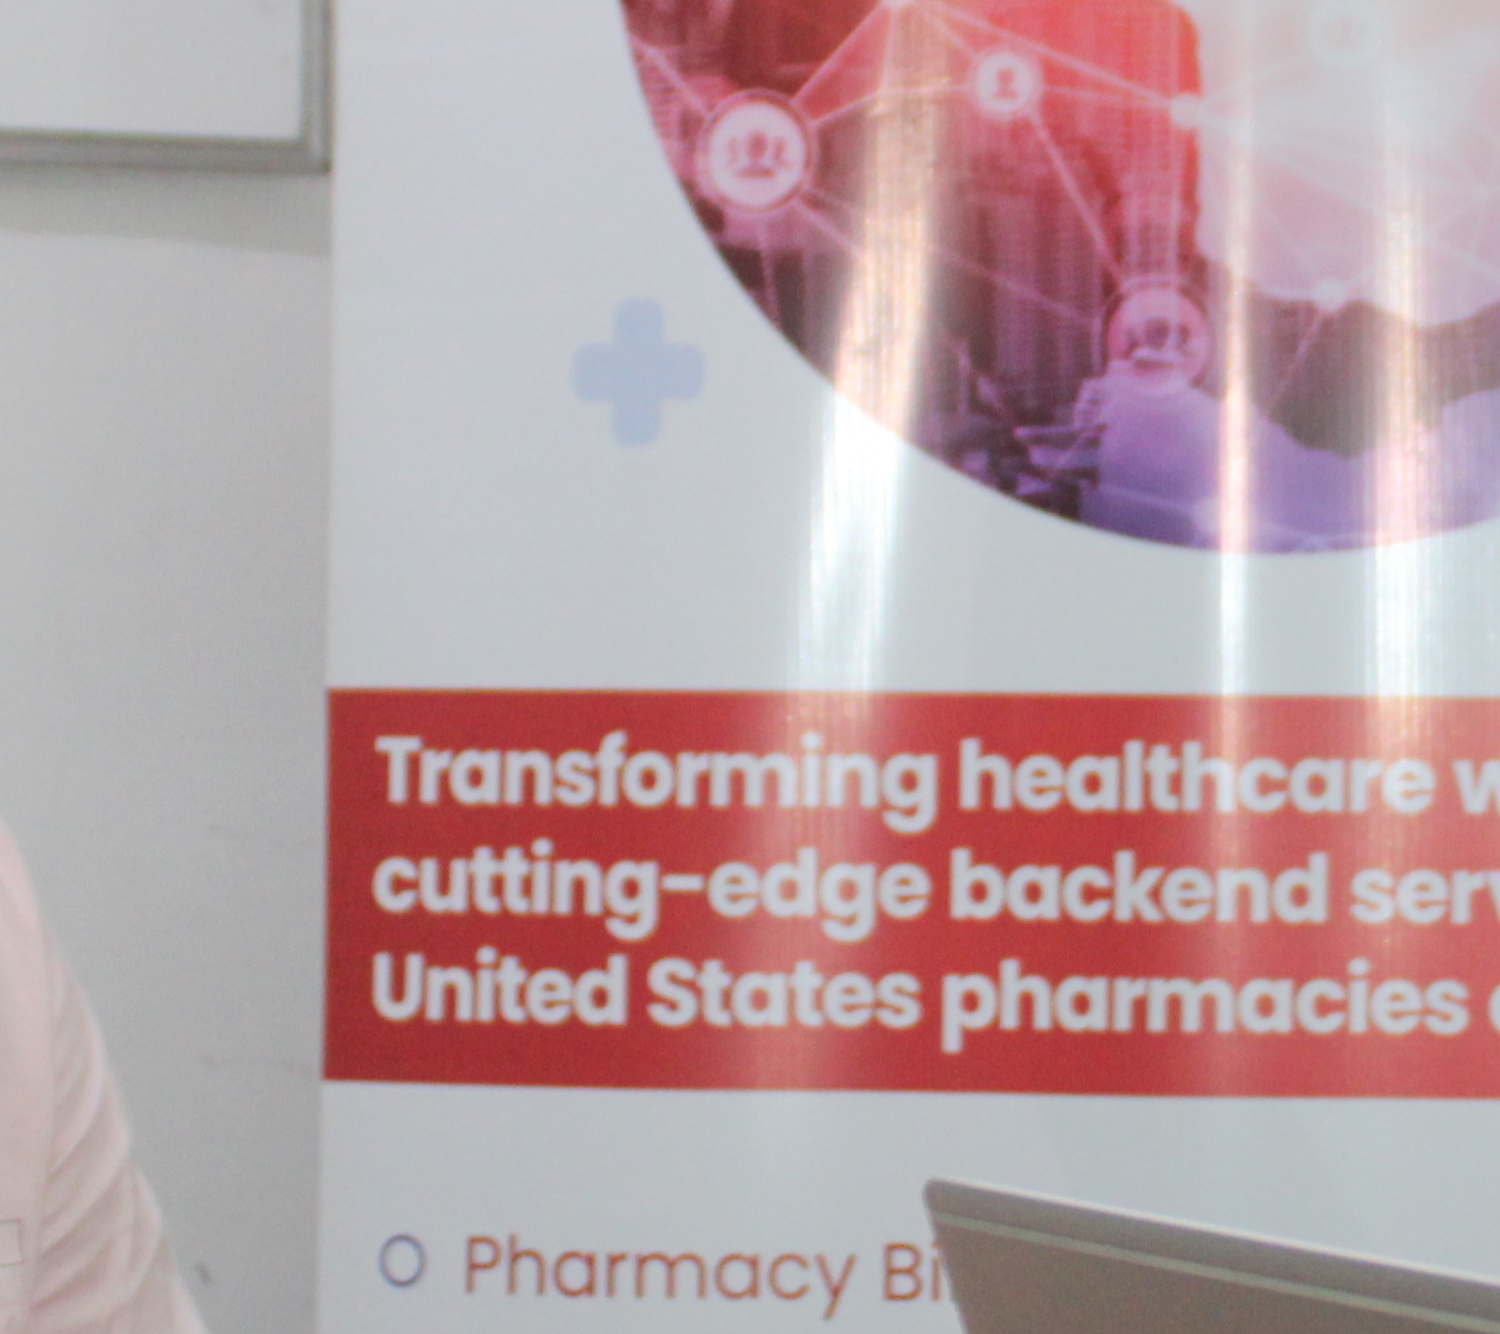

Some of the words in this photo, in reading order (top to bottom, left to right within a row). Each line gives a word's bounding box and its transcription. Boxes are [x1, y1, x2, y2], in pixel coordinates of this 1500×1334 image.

[374, 730, 939, 834] Transforming
[959, 737, 1437, 814] healthcare
[372, 837, 933, 942] cutting-edge
[949, 847, 1330, 925] backend
[372, 945, 629, 1026] United
[646, 957, 923, 1028] States
[940, 956, 1472, 1054] pharmacies
[464, 1233, 858, 1322] Pharmacy
